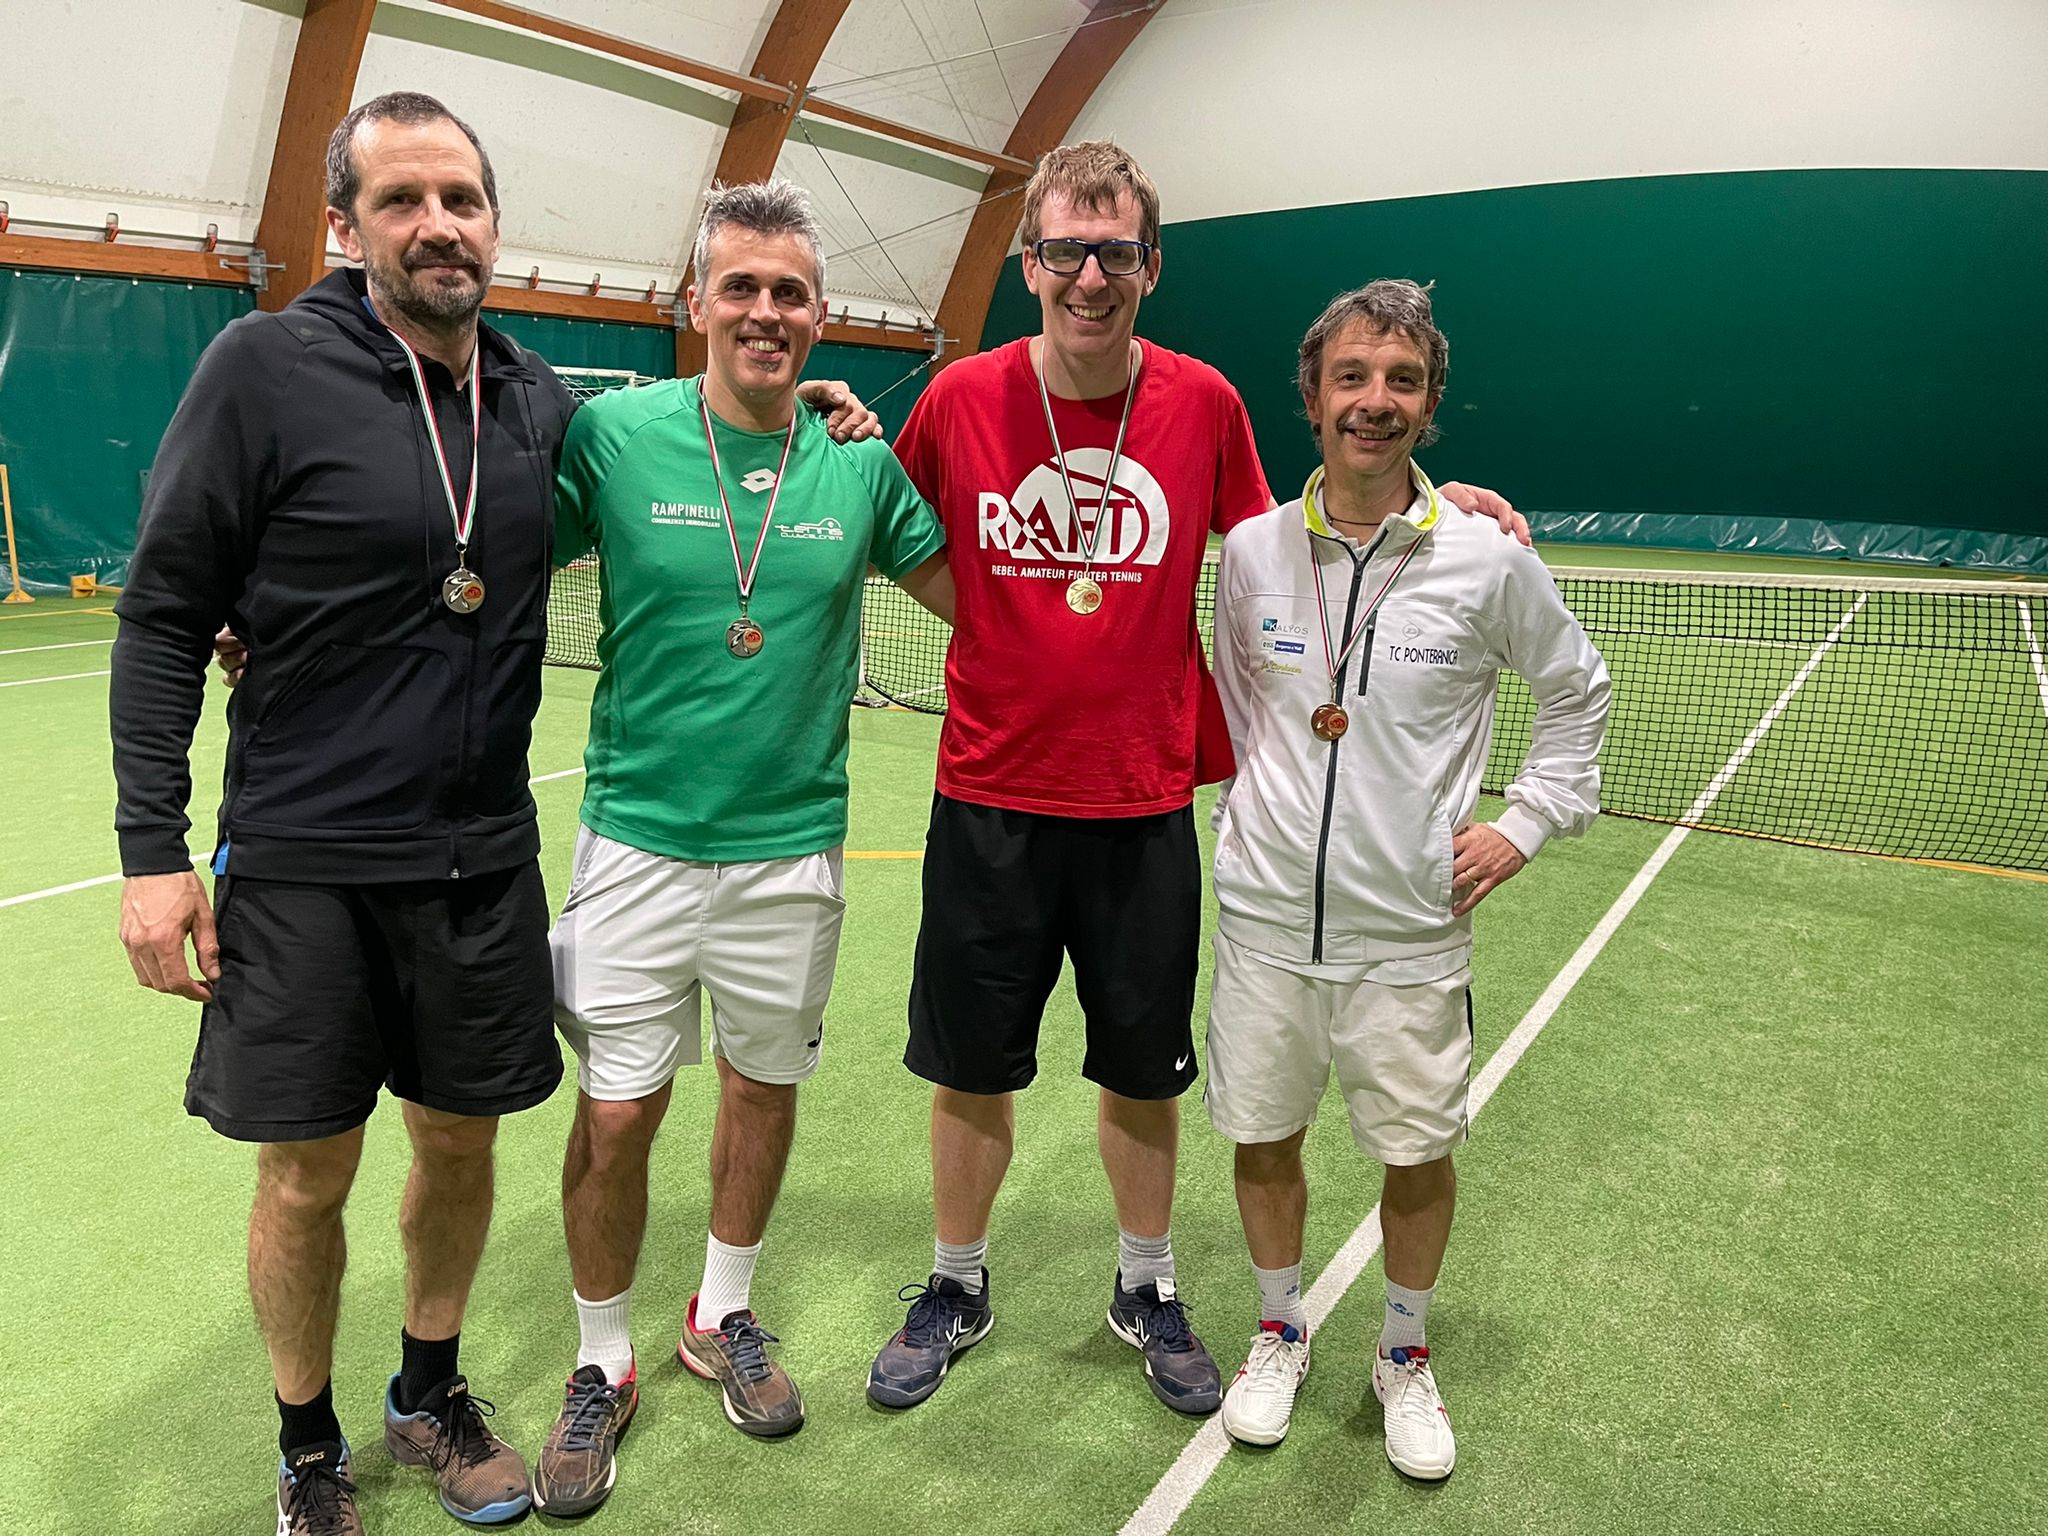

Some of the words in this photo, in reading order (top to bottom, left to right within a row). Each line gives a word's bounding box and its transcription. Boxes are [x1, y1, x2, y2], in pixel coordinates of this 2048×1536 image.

[651, 502, 720, 520] RAMPINELLI
[991, 564, 1018, 577] REBEL
[1020, 566, 1065, 580] AMATEUR
[1110, 571, 1142, 583] TENNIS
[1269, 621, 1309, 635] KALYOS
[1389, 646, 1401, 661] TC
